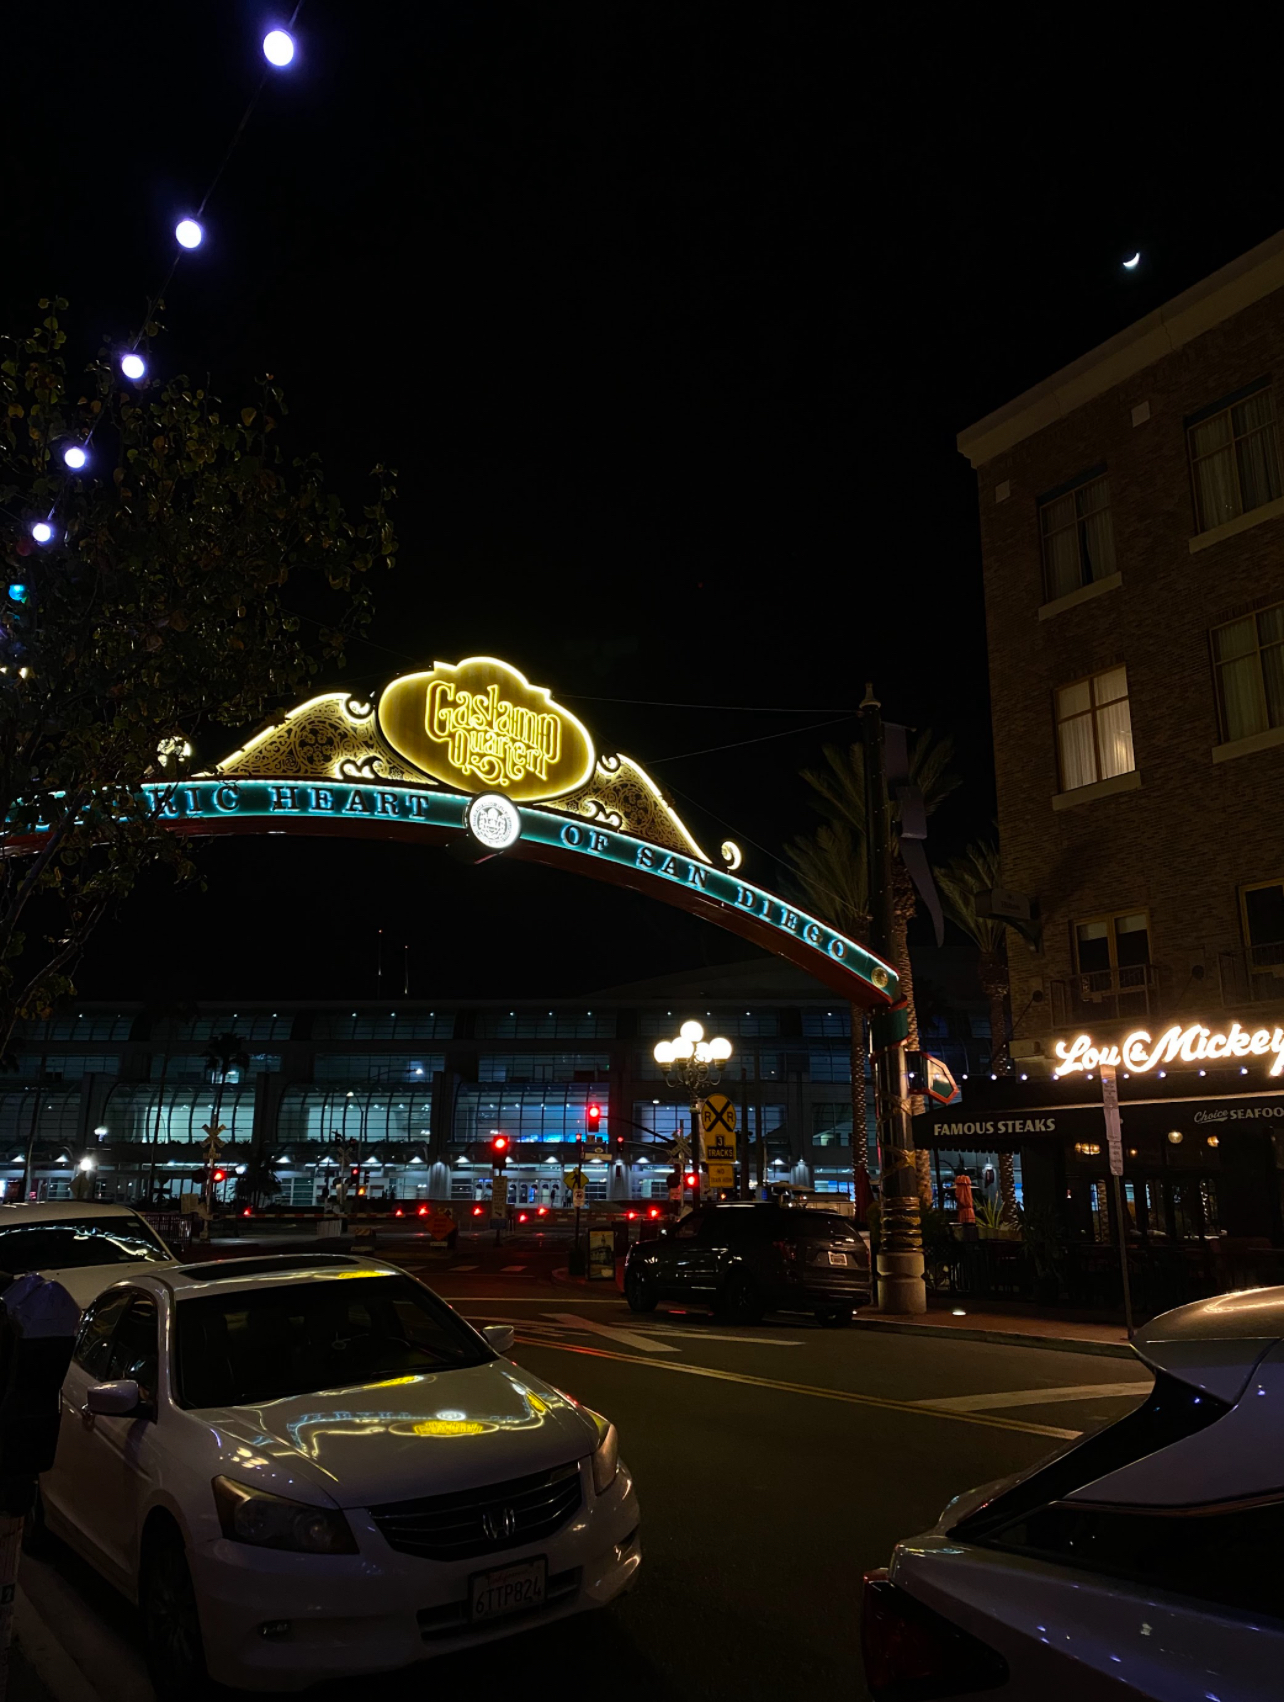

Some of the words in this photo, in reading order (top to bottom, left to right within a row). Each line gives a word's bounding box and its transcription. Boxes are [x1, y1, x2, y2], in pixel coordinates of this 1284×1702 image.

[425, 680, 562, 763] Gaslamp
[448, 727, 549, 786] Quarter
[269, 785, 429, 821] HEART
[560, 824, 610, 855] OF
[635, 845, 711, 891] SAN
[734, 885, 849, 960] DIEGO
[1055, 1034, 1121, 1076] Lou
[933, 1122, 995, 1136] FAMOUS
[997, 1118, 1056, 1133] STEAKS
[1194, 1104, 1229, 1124] Choice
[707, 1148, 734, 1158] TRACKS
[717, 1136, 723, 1147] 3
[475, 1576, 542, 1614] 6TTP824
